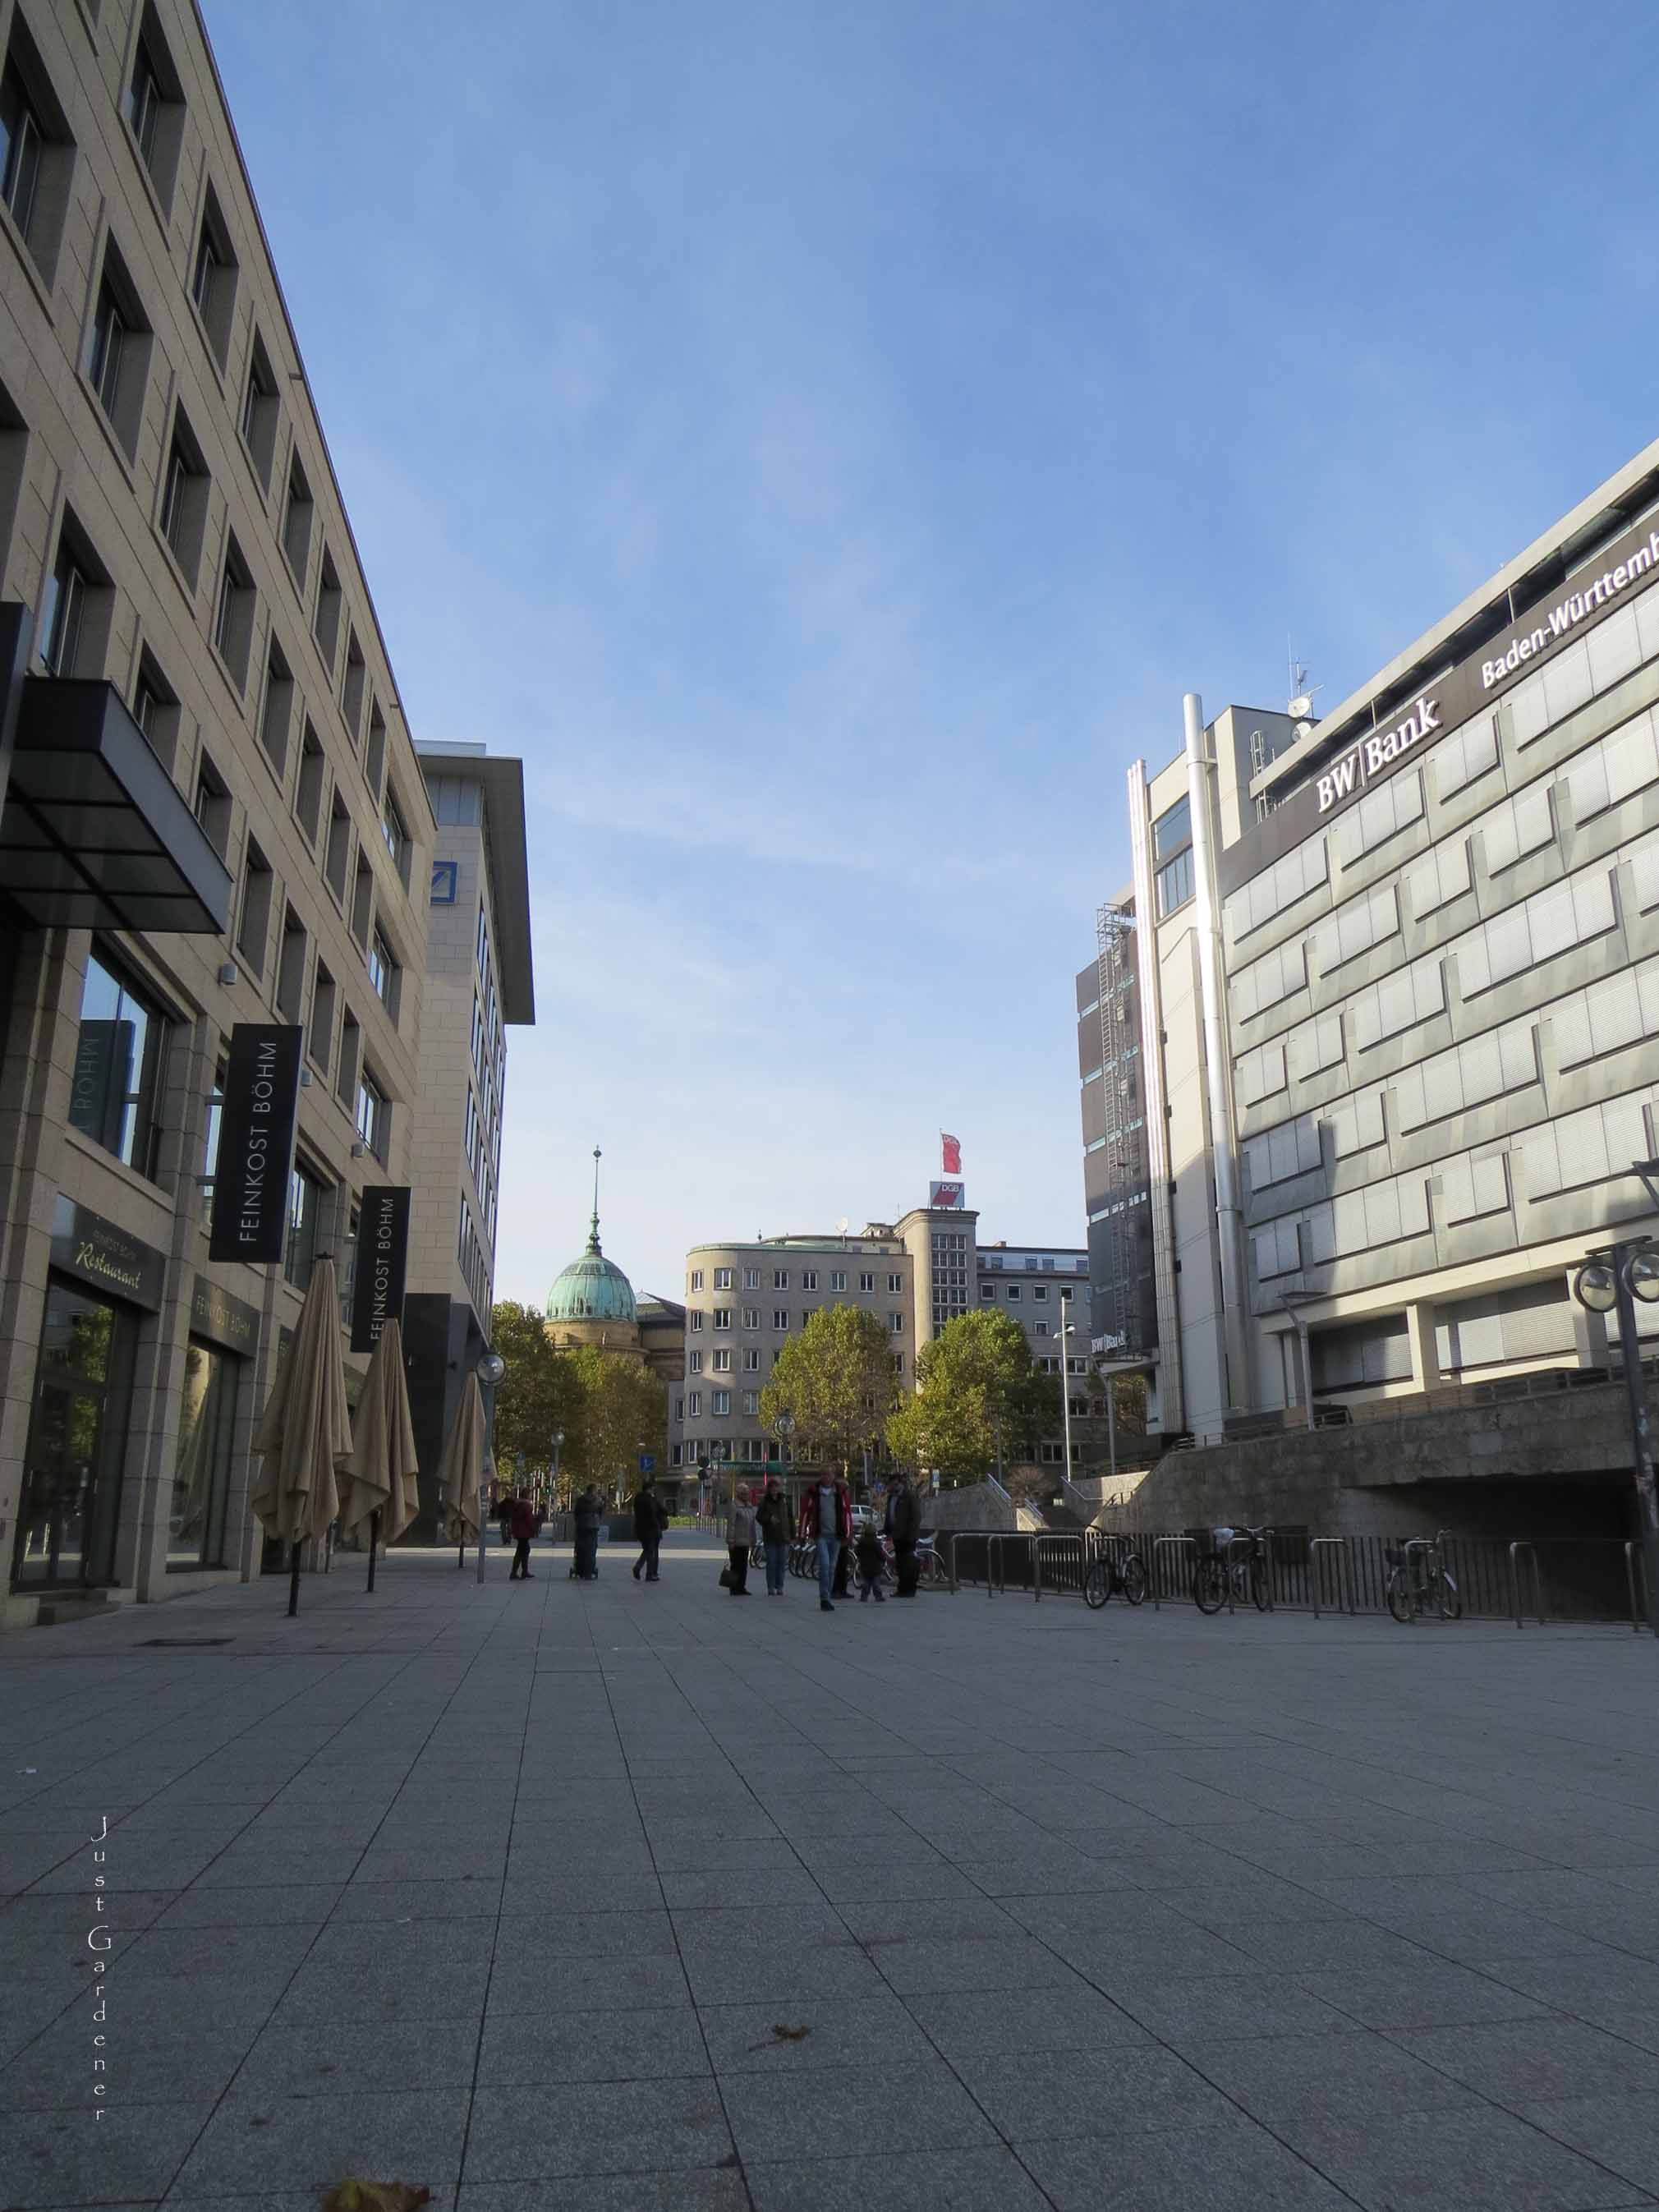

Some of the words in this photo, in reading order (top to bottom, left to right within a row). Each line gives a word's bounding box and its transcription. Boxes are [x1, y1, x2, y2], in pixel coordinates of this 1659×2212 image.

[250, 1042, 277, 1113] BÖHM
[239, 1125, 269, 1243] FEINKOST
[941, 1184, 960, 1192] DGB
[377, 1198, 394, 1249] BÖHM
[76, 1241, 141, 1289] Restaurant
[370, 1258, 390, 1340] FEINKOST
